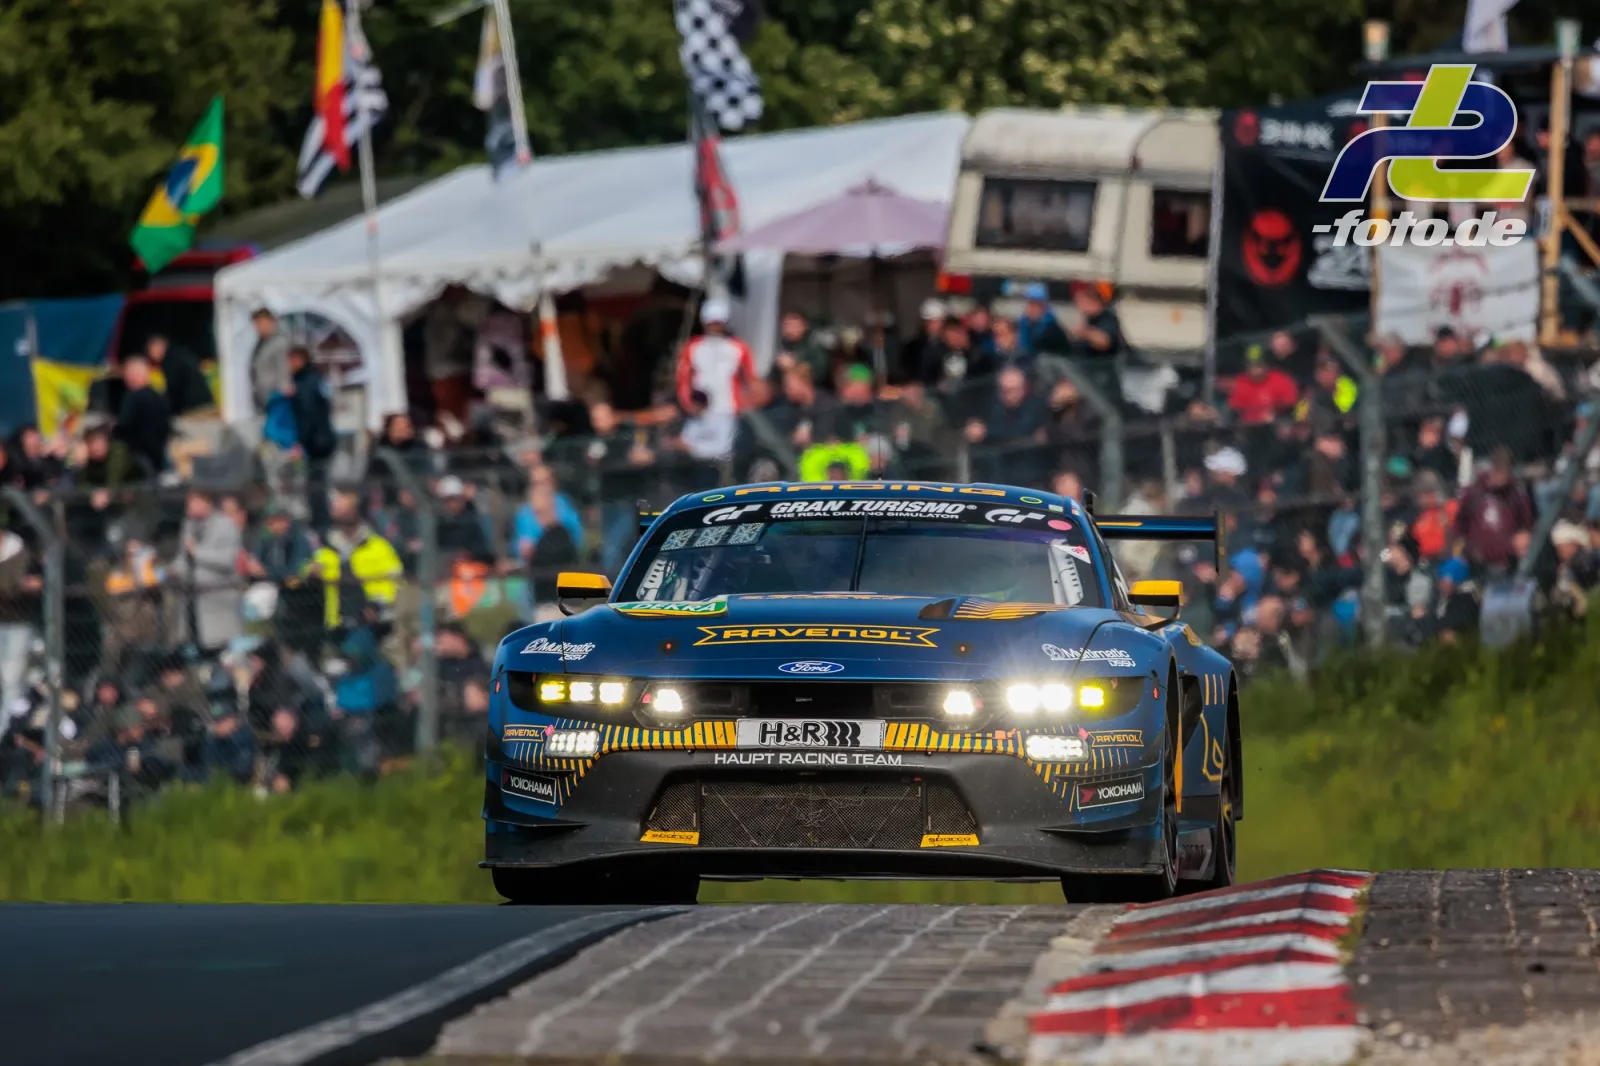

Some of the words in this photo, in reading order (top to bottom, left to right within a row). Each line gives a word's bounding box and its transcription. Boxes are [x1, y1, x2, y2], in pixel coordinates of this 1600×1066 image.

[770, 500, 847, 513] GRAN
[886, 511, 960, 520] SIMULATOR
[631, 602, 717, 612] DEKRA
[722, 628, 912, 641] RAVENOL
[1061, 647, 1130, 659] Multimatic
[790, 660, 831, 673] Ford
[505, 728, 540, 737] RAVENOL
[759, 720, 826, 747] H&R
[1095, 734, 1140, 743] RAVENOL
[714, 752, 775, 764] HAUPT
[778, 753, 848, 765] RACING
[852, 754, 902, 765] TEAM
[510, 775, 553, 797] YOKOHAMA
[1097, 781, 1143, 800] YOKOHAMA
